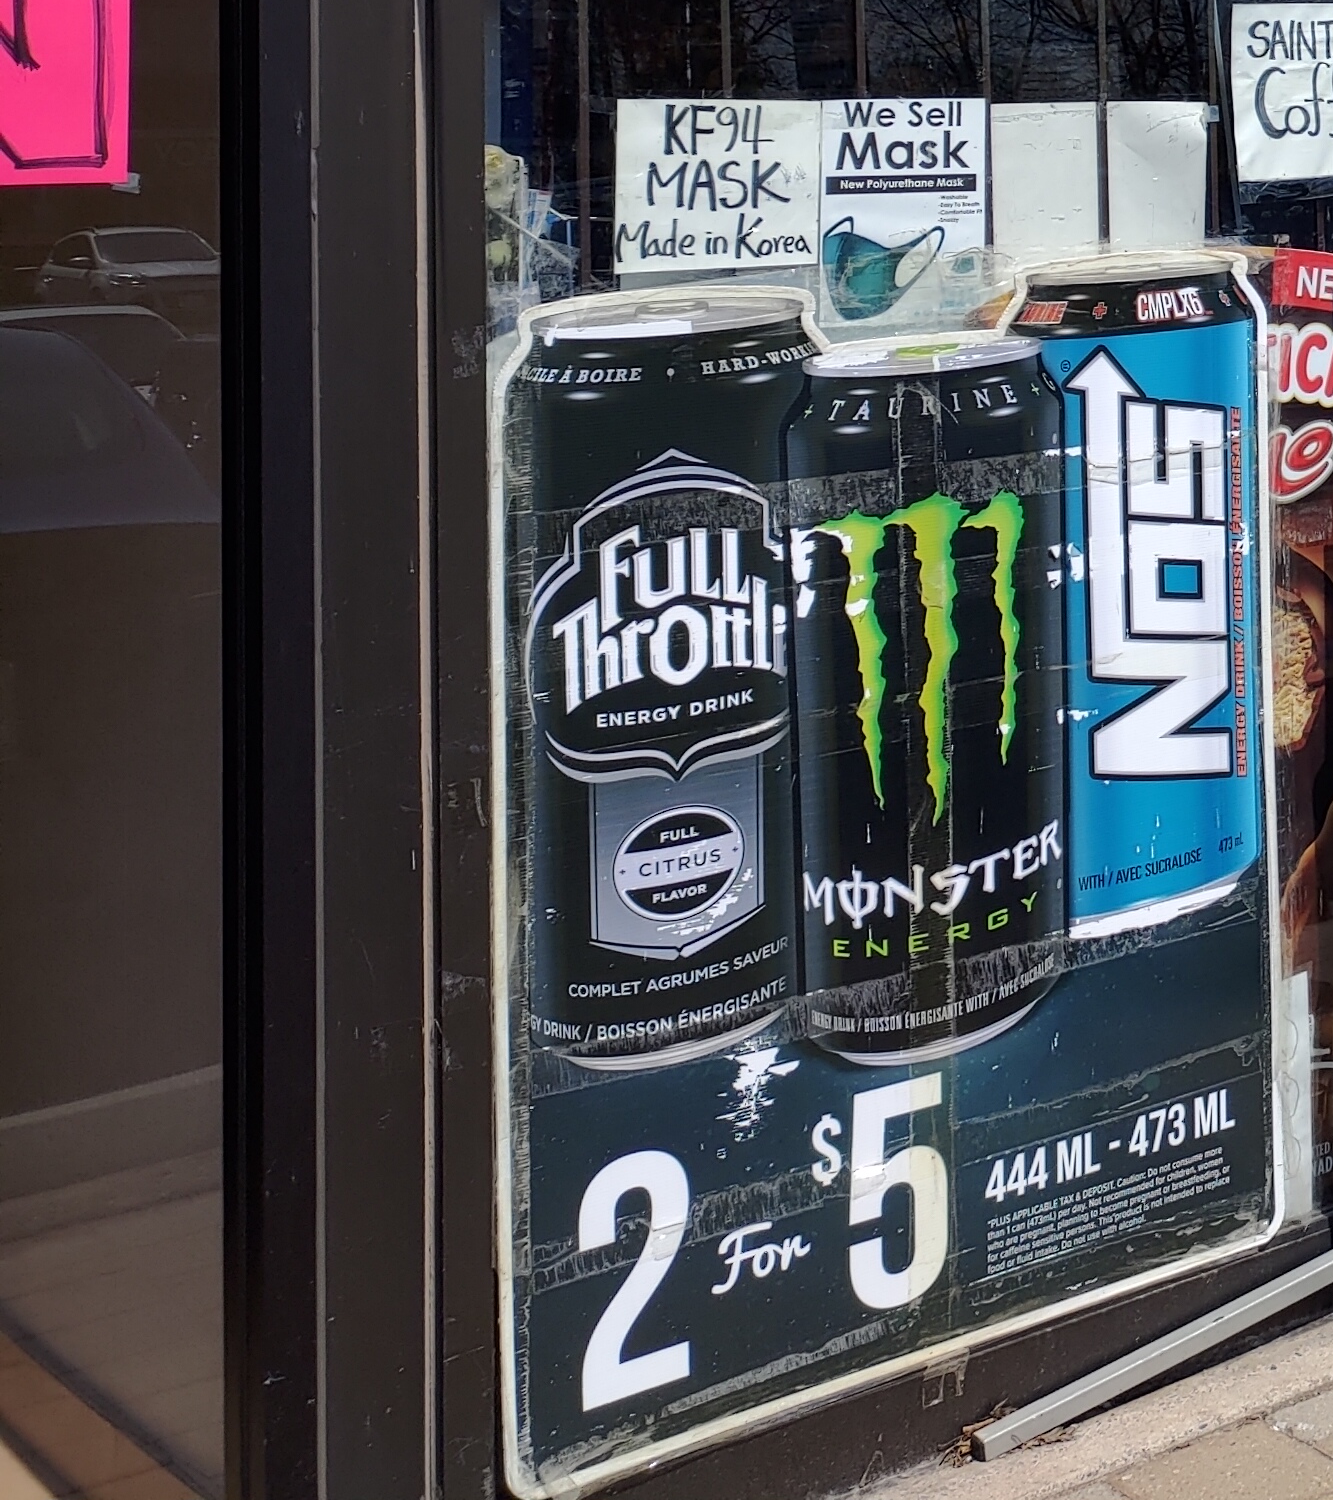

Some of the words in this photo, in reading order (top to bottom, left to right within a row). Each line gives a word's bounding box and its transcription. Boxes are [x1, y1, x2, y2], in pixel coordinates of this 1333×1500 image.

[664, 104, 775, 156] KF94
[844, 101, 896, 127] We
[907, 101, 962, 127] Sell
[835, 130, 970, 170] Mask
[646, 159, 792, 211] MASK
[840, 180, 865, 190] New
[936, 177, 964, 188] Mask
[615, 218, 695, 262] Made
[705, 231, 729, 255] in
[735, 213, 812, 259] Korea
[576, 367, 643, 384] BOIRE
[826, 384, 1018, 421] TAURINE
[1064, 345, 1232, 779] NOS
[1234, 638, 1246, 700] DRINK
[595, 704, 681, 728] ENERGY
[690, 688, 754, 715] DRINK
[1235, 702, 1248, 777] ENERGY
[660, 825, 700, 844] FULL
[639, 846, 722, 878] CITRUS
[1078, 872, 1105, 891] WITH
[1115, 865, 1142, 885] AVEC
[1145, 847, 1202, 877] SUCRALOSE
[652, 882, 708, 905] FLAVOR
[833, 891, 1038, 958] ENERGY
[568, 980, 642, 998] COMPLET
[646, 962, 730, 993] AGRUMES
[733, 936, 788, 971] SAVEUR
[544, 1022, 581, 1041] DRINK
[596, 1017, 673, 1041] BOISSON
[678, 975, 788, 1029] ÉNERGISANTE
[984, 1145, 1050, 1203] 444
[1056, 1131, 1102, 1185] ML
[1128, 1103, 1187, 1157] 473
[1194, 1088, 1236, 1139] ML
[578, 1148, 691, 1414] 2
[712, 1219, 811, 1297] For
